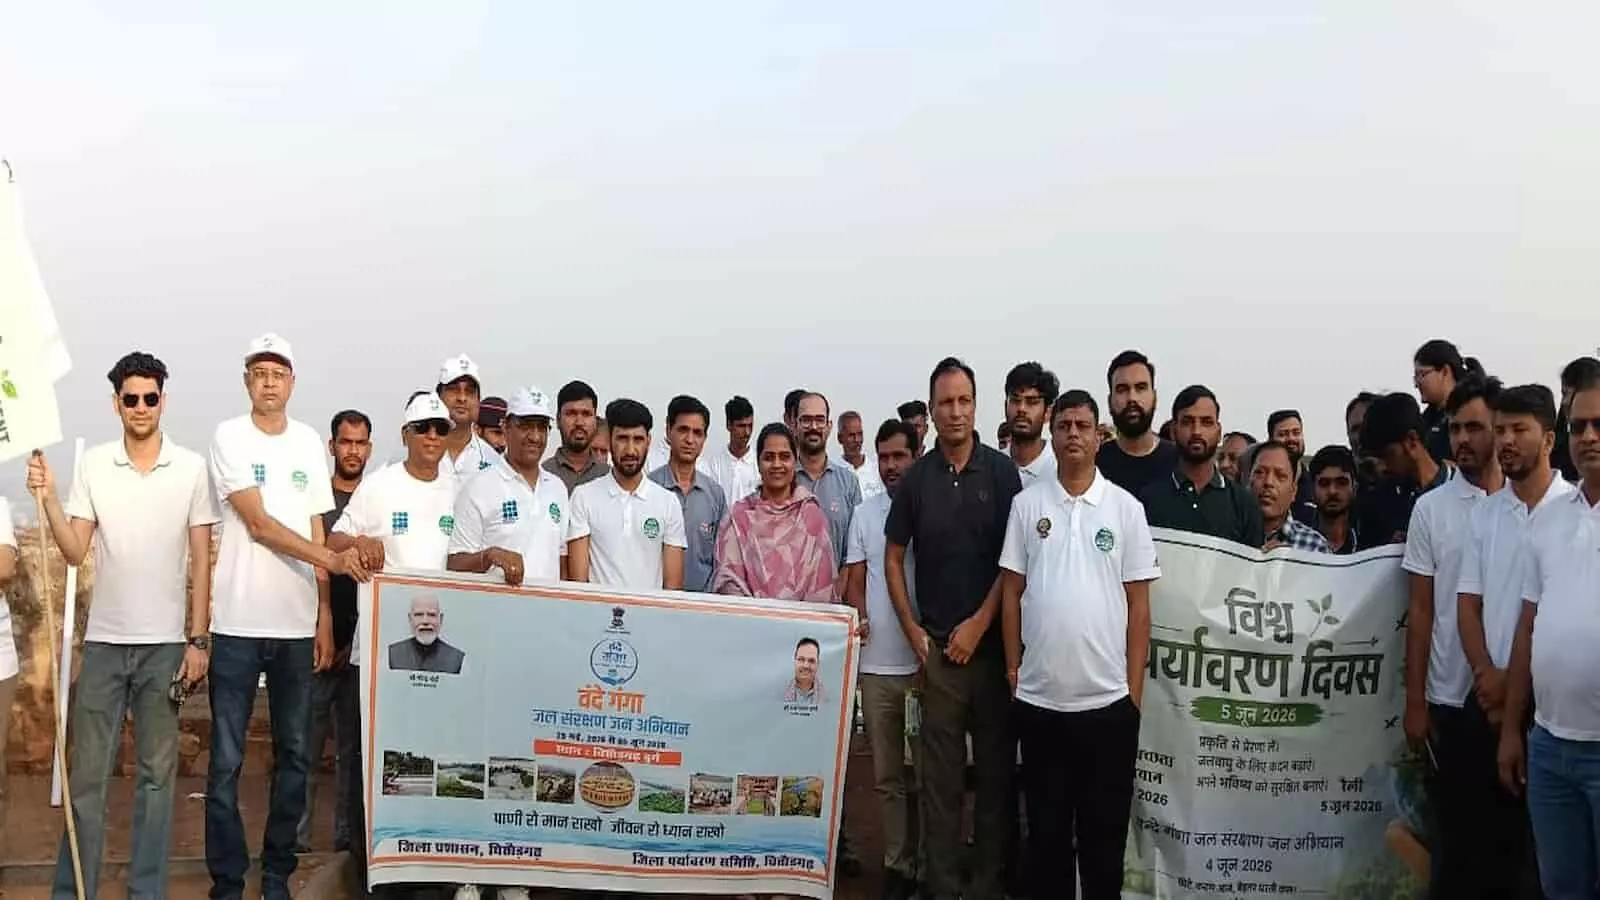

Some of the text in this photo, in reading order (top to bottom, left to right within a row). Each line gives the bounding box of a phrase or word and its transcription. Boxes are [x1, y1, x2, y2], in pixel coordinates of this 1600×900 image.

[1224, 587, 1294, 644] विश्व
[1301, 640, 1384, 699] दिवस
[577, 684, 646, 714] वंदे गंगा
[532, 709, 691, 737] जल संरक्षण जन अभियान
[1221, 704, 1297, 728] 5 जून 2026
[1199, 734, 1229, 752] प्रकृति
[1138, 750, 1176, 768] च्छता
[1135, 768, 1164, 784] यान
[1137, 788, 1169, 806] 2026
[1320, 800, 1328, 812] 5
[494, 811, 726, 840] पाणी रो मान राखो जीवन रो ध्यान राखो
[398, 839, 432, 853] जिला
[1195, 832, 1217, 847] जल
[632, 852, 665, 867] जिला
[668, 852, 716, 867] पर्यावरण
[1206, 858, 1272, 877] 4 जून 2026
